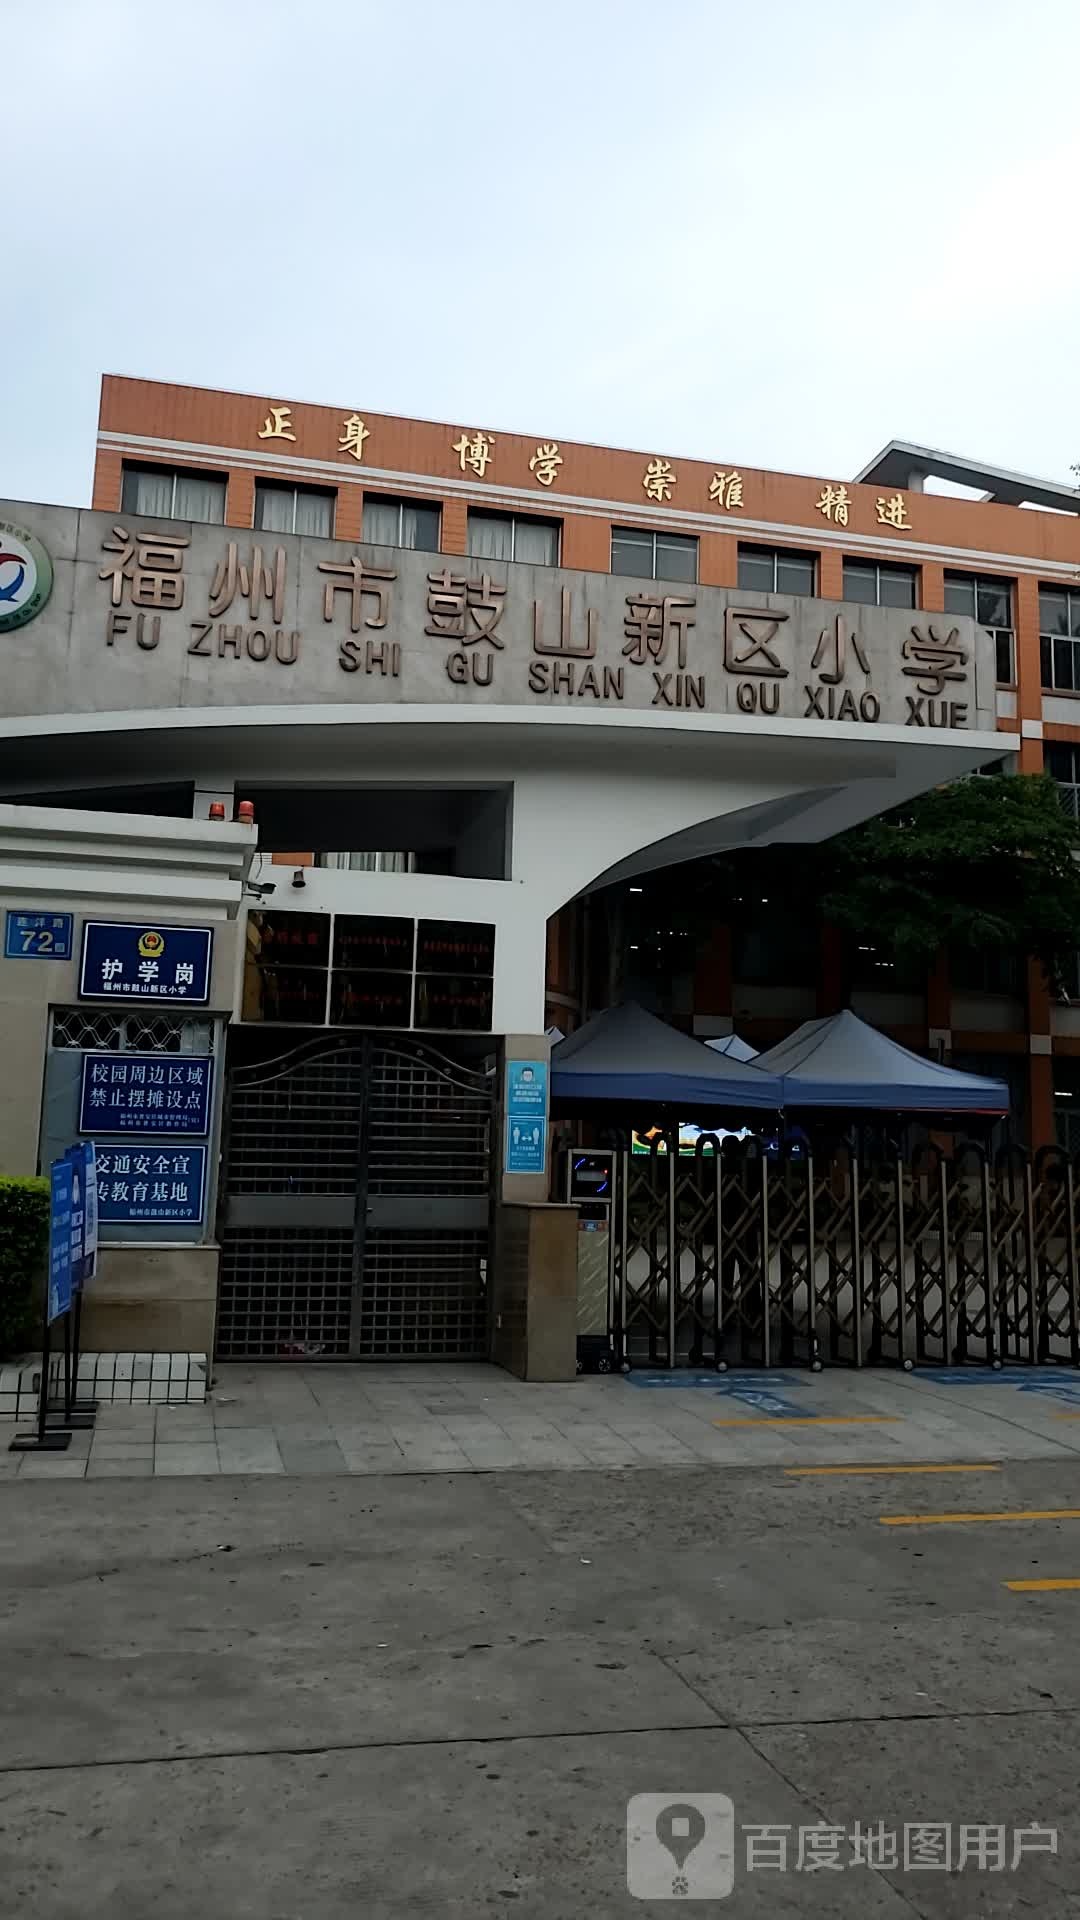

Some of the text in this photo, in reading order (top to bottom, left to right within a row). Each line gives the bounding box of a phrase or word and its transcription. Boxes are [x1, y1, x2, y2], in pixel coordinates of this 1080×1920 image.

[257, 406, 912, 531] 正身 博学 崇雅 精进
[98, 527, 968, 695] 福州市鼓山新区小学
[106, 610, 968, 730] FU ZHOU SHI GU SHAN XIN QU XIAO XUE
[20, 931, 54, 952] 72
[101, 958, 194, 985] 护学岗
[103, 981, 187, 994] 福州市鼓山新区小学
[90, 1063, 204, 1085] 校园周边区域
[89, 1087, 201, 1109] 禁止摆摊设点
[95, 1154, 190, 1175] 交通安全宣
